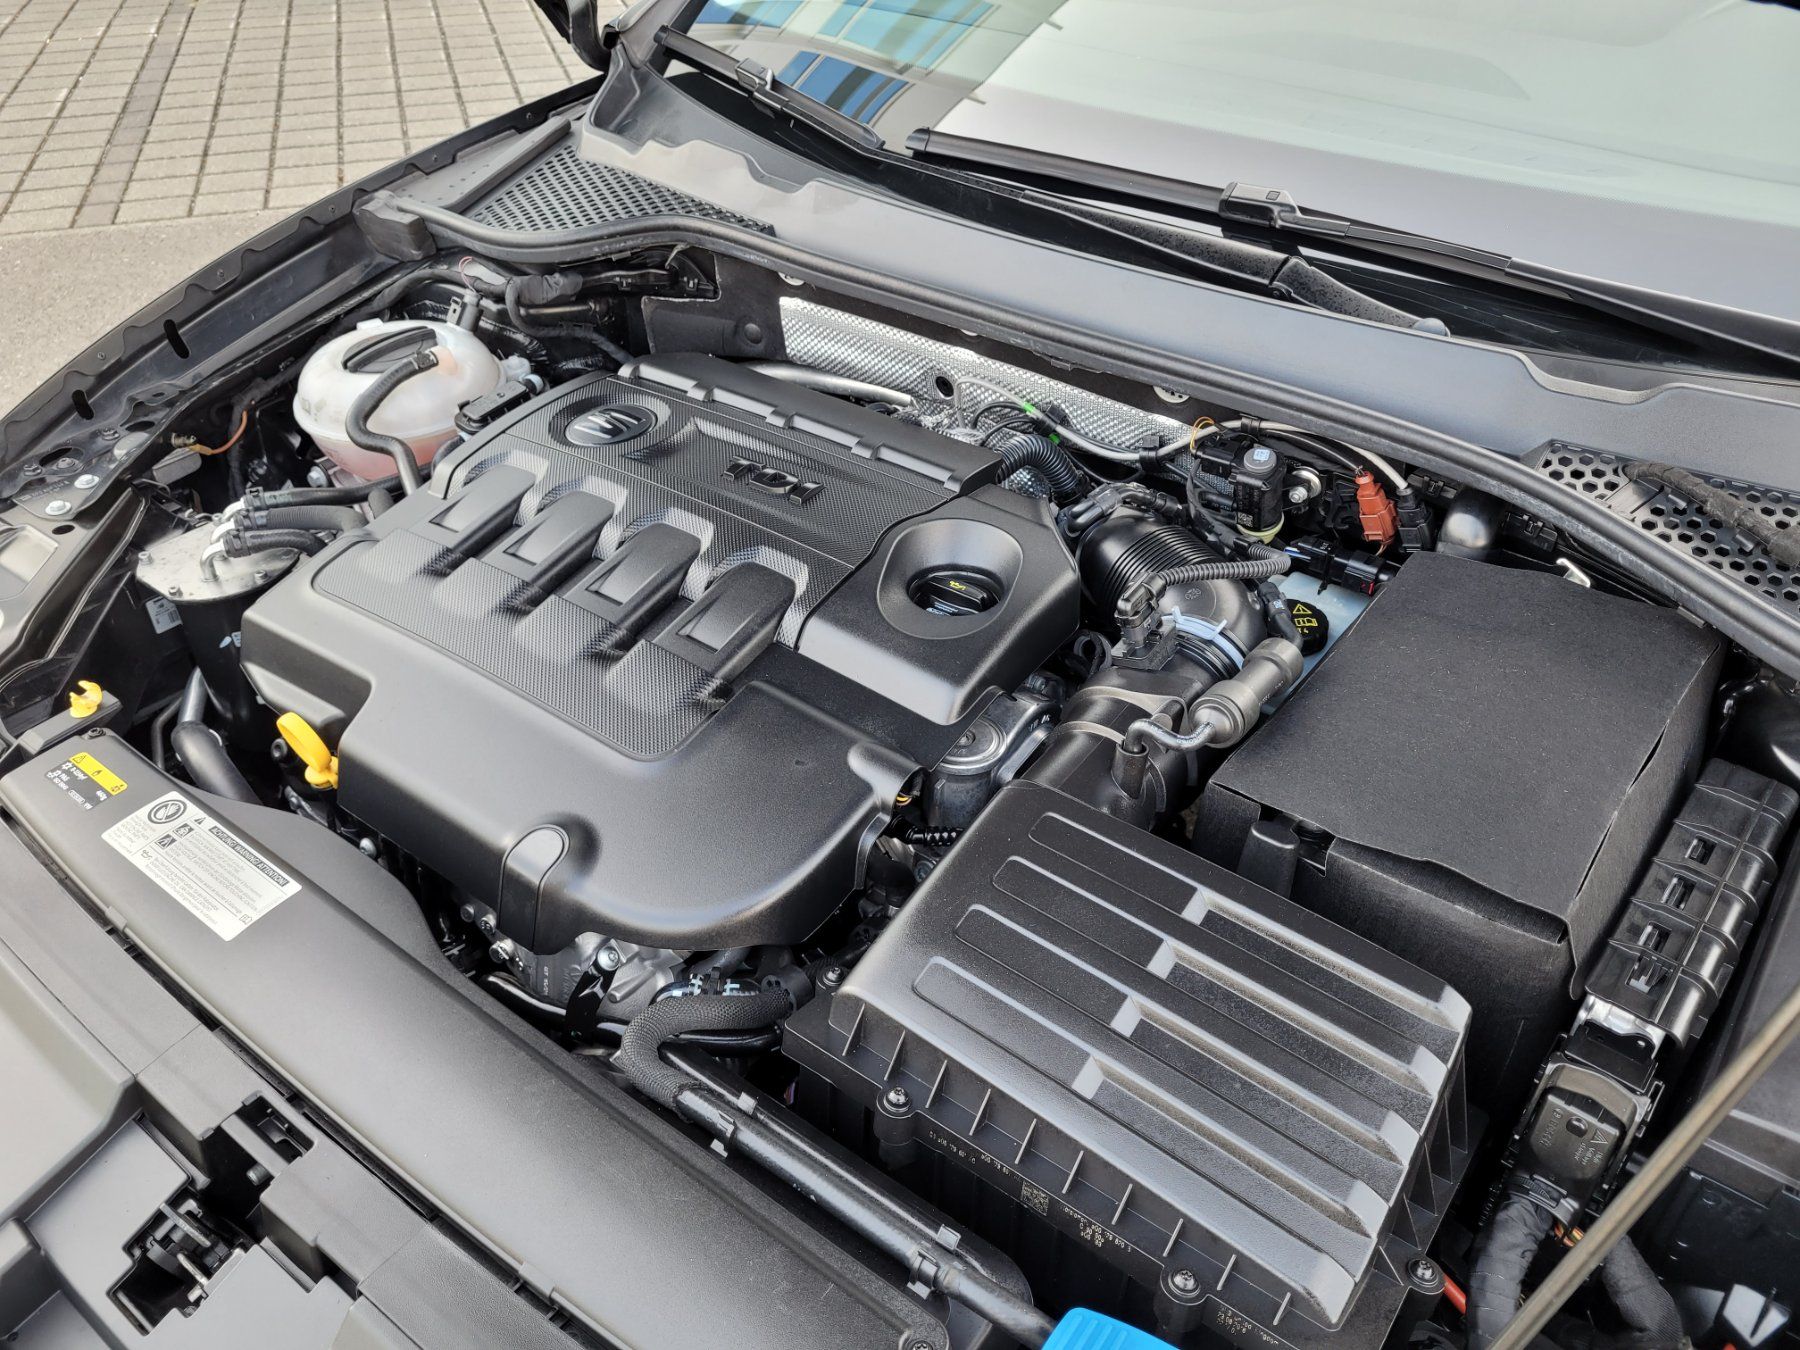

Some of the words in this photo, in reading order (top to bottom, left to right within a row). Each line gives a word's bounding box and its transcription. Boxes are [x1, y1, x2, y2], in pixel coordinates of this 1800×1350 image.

[722, 455, 825, 505] TDI
[234, 843, 261, 866] WARNING!
[257, 861, 288, 886] ATTENTION!
